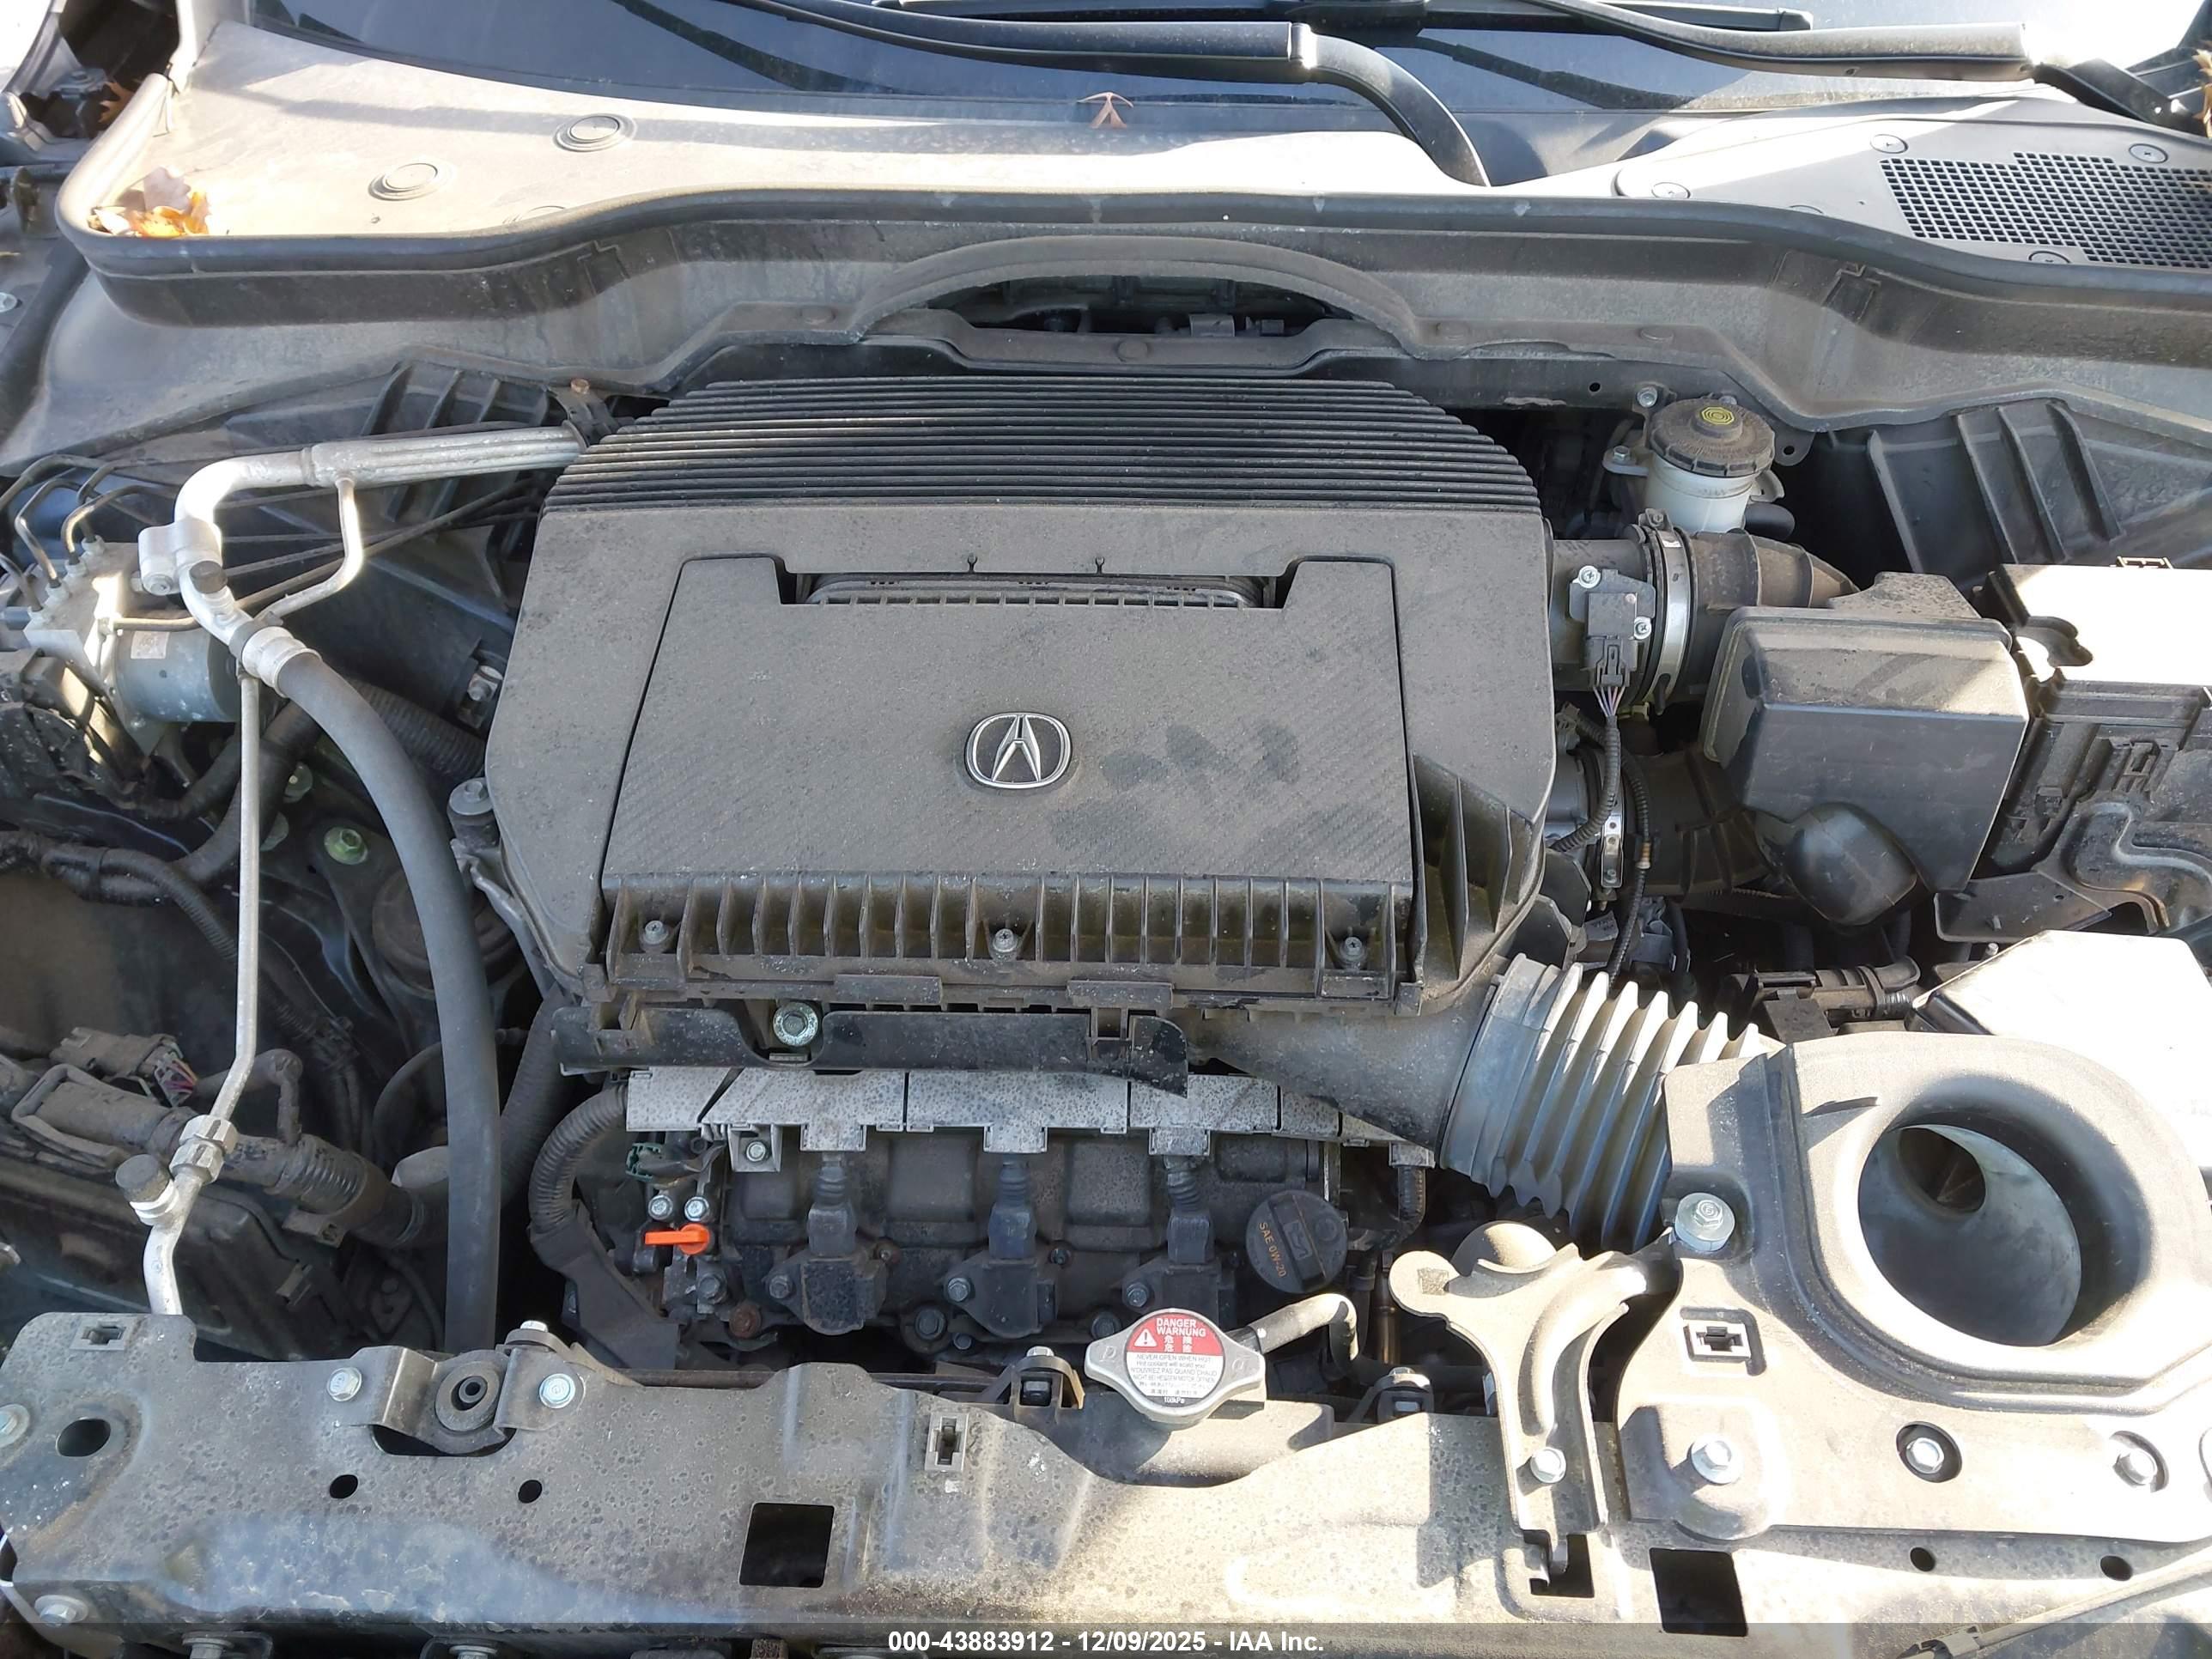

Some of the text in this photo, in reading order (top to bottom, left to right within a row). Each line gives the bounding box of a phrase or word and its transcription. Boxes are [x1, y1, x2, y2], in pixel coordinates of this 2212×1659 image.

[1259, 1222, 1286, 1278] SAE 0W-20
[1157, 1318, 1196, 1327] DANGER
[1157, 1327, 1206, 1337] WARNUNG
